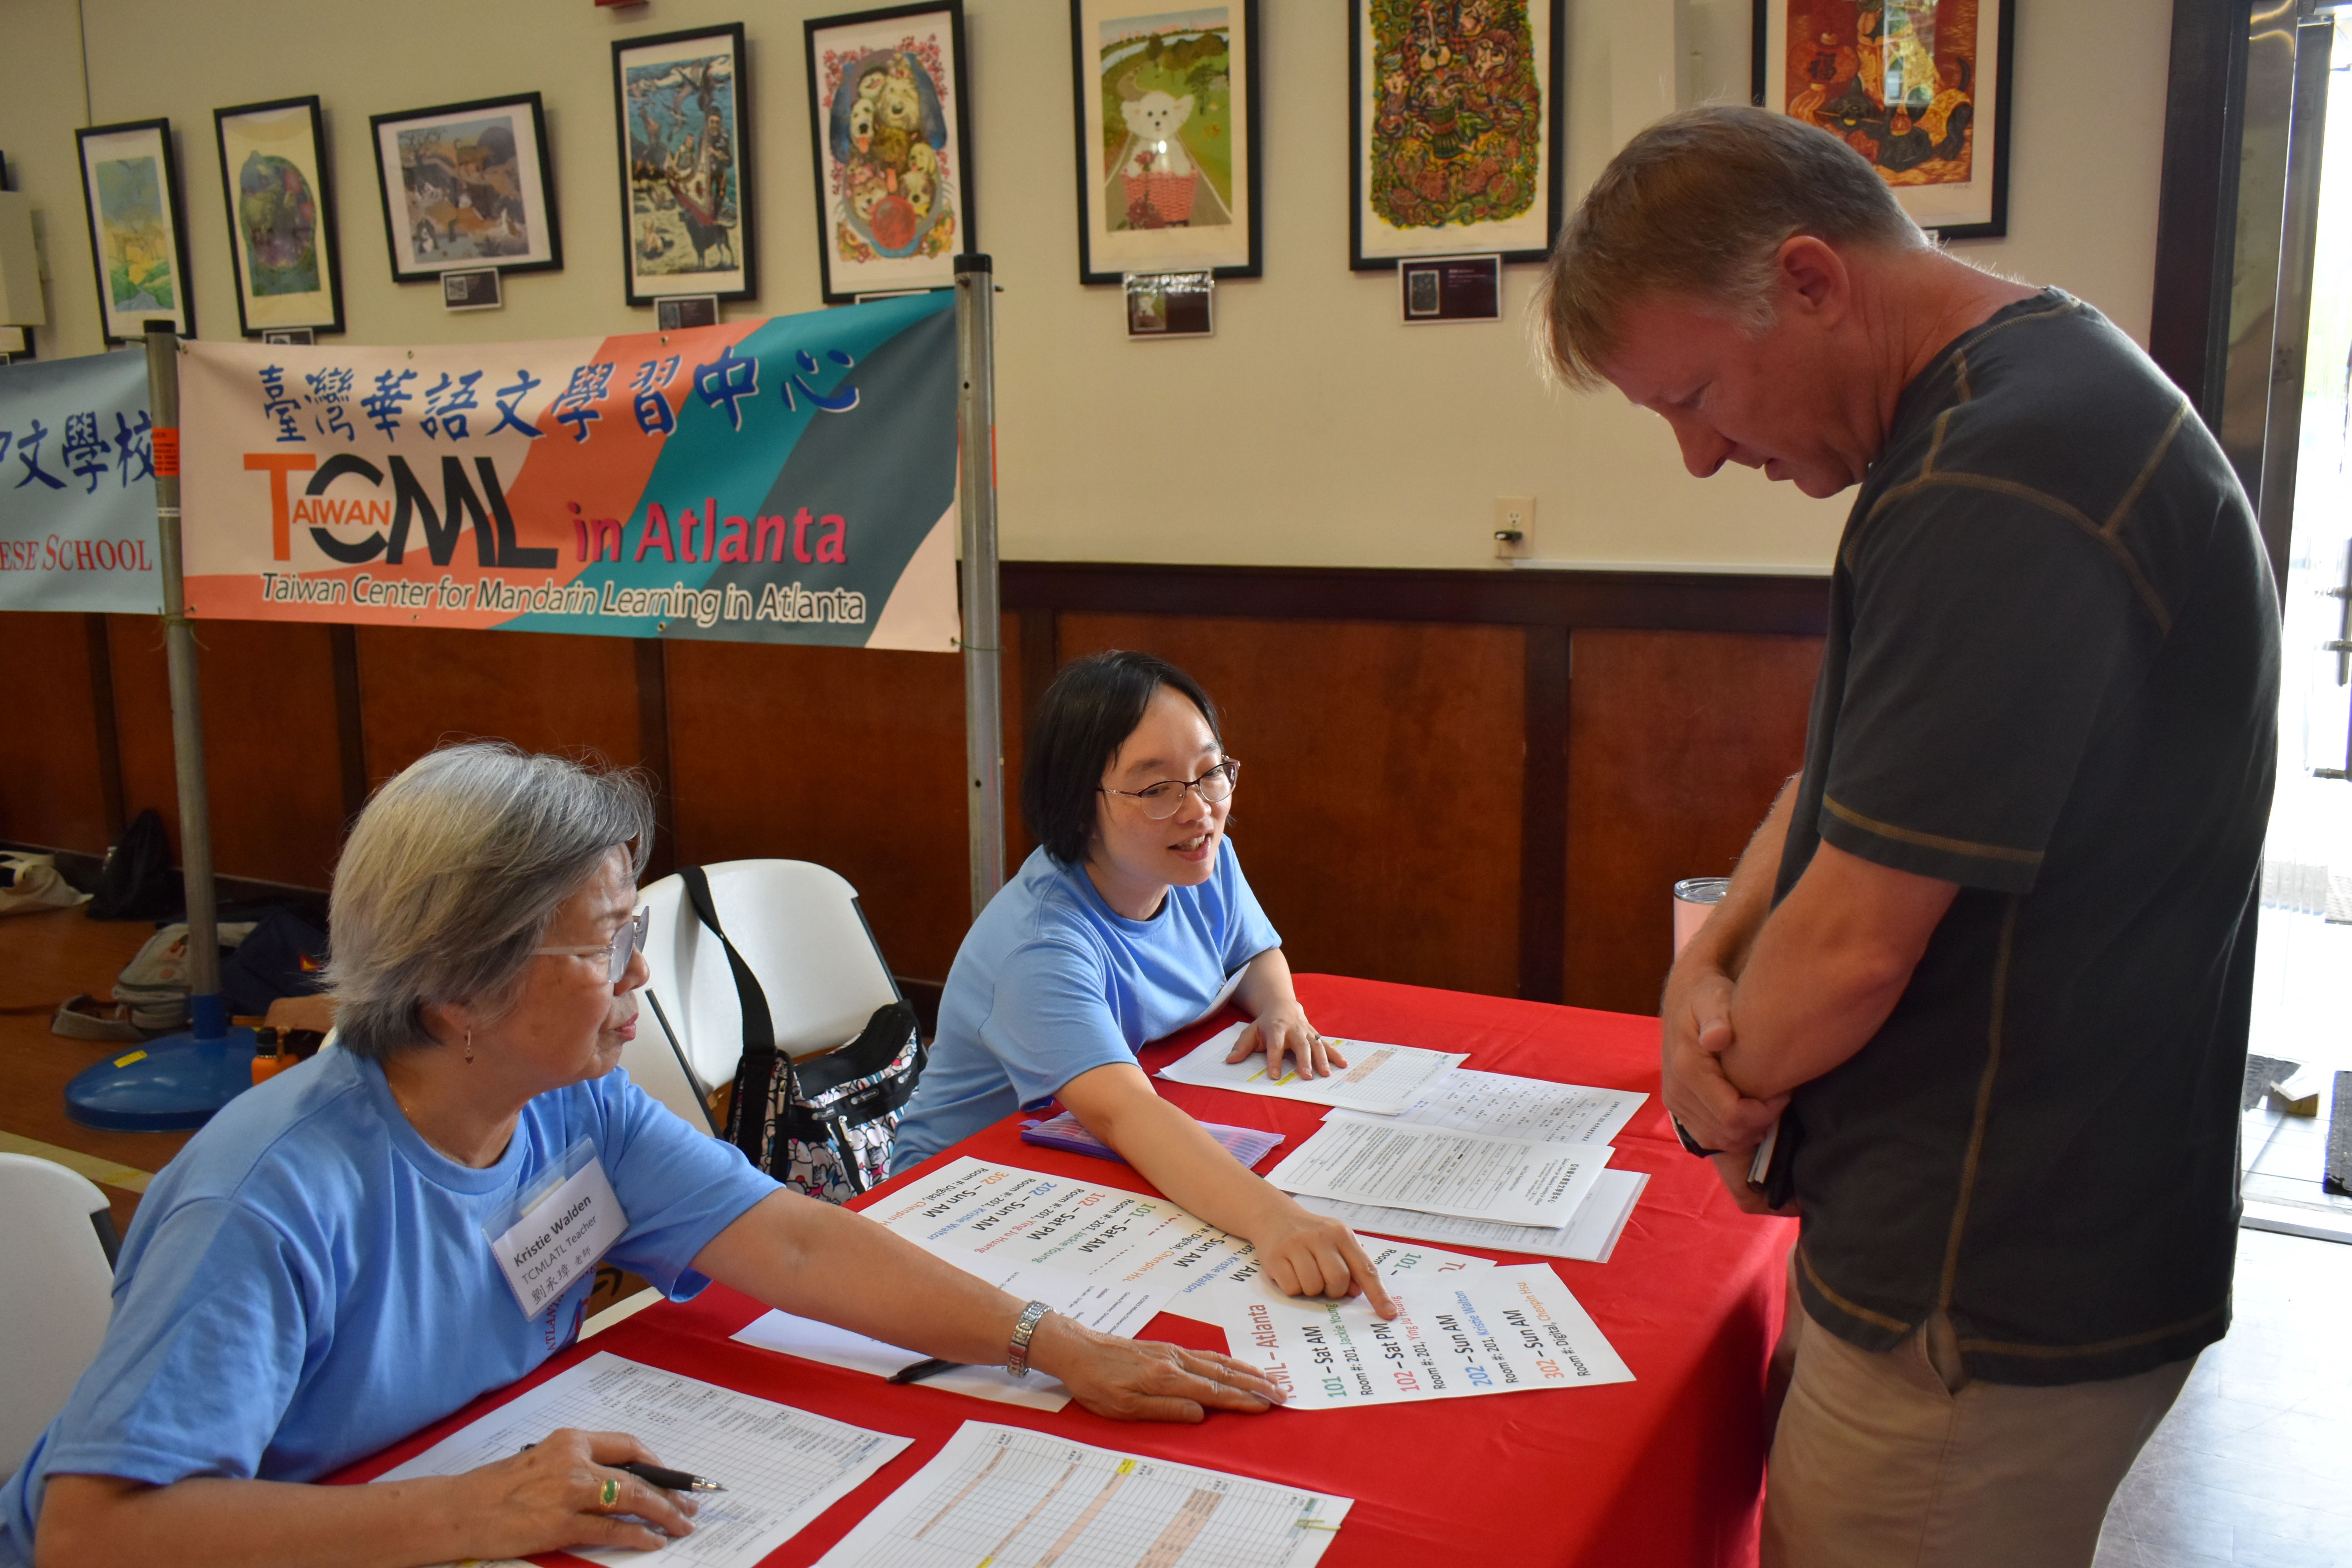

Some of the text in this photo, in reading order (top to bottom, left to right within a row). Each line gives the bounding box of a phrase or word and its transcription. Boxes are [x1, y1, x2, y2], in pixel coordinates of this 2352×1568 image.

[259, 346, 859, 444] 臺灣華語文學習中心
[567, 502, 622, 561] in
[634, 497, 847, 563] Atlanta
[42, 534, 153, 571] SCHOOL
[262, 572, 865, 627] Taiwan Center for Mandarin Learning in Atlanta
[961, 1168, 989, 1180] Room
[980, 1171, 1009, 1185] 302
[922, 1185, 956, 1200] Digital,
[1009, 1178, 1036, 1192] Room
[1028, 1182, 1057, 1195] 202
[946, 1190, 976, 1203] Sun
[981, 1197, 1004, 1207] 201,
[1058, 1189, 1085, 1203] Room
[1078, 1192, 1105, 1207] 102
[888, 1201, 926, 1220] Chenpin
[922, 1203, 951, 1218] AM
[995, 1201, 1025, 1215] Sun
[1031, 1209, 1054, 1219] 201,
[1109, 1199, 1135, 1214] Room
[1129, 1203, 1156, 1218] 101
[956, 1207, 986, 1223] Kristie
[971, 1216, 1000, 1230] AM
[1048, 1213, 1075, 1226] Sat
[514, 1195, 592, 1268] Kristie Walden
[1012, 1220, 1037, 1230] Ying
[1027, 1226, 1056, 1240] PM
[1082, 1220, 1105, 1230] 201,
[1100, 1225, 1127, 1238] Sat
[974, 1237, 1008, 1253] Huang
[1059, 1231, 1087, 1247] Jackie
[1078, 1238, 1106, 1252] AM
[1169, 1234, 1202, 1250] Digital,
[1195, 1238, 1225, 1252] Sun
[522, 1216, 596, 1285] TCMLATL Teacher
[574, 1246, 591, 1266] 老師
[1031, 1247, 1064, 1263] Young
[1373, 1249, 1397, 1265] Room
[1138, 1250, 1175, 1272] Chenpin
[1173, 1252, 1201, 1267] AM
[1211, 1256, 1240, 1272] Kristie
[1394, 1253, 1421, 1269] 101
[1229, 1265, 1258, 1282] AM
[1183, 1273, 1217, 1293] Walton
[1517, 1282, 1532, 1294] Hsu
[1392, 1296, 1407, 1316] Huang
[1455, 1291, 1475, 1314] Walton
[1525, 1295, 1550, 1321] Chenpin
[1326, 1303, 1341, 1324] Young
[1503, 1310, 1530, 1326] AM
[1249, 1305, 1279, 1348] Atlanta
[1370, 1323, 1394, 1339] PM
[1436, 1315, 1461, 1331] AM
[1468, 1315, 1489, 1336] Kristie
[1302, 1327, 1325, 1343] AM
[1334, 1325, 1352, 1345] Jackie
[1405, 1326, 1420, 1340] Ying
[1520, 1329, 1543, 1348] Sun
[1543, 1322, 1569, 1346] Digital,
[1381, 1342, 1404, 1359] Sat
[1412, 1341, 1430, 1357] 201,
[1452, 1334, 1474, 1353] Sun
[1482, 1337, 1499, 1352] 201,
[1312, 1347, 1333, 1364] Sat
[1343, 1346, 1360, 1363] 201,
[1498, 1362, 1519, 1383] Room
[1536, 1359, 1564, 1379] 302
[1569, 1355, 1591, 1377] Room
[1394, 1371, 1420, 1392] 102
[1428, 1367, 1446, 1389] Room
[1465, 1365, 1493, 1386] 202
[1322, 1376, 1347, 1397] 101
[1356, 1373, 1374, 1396] Room
